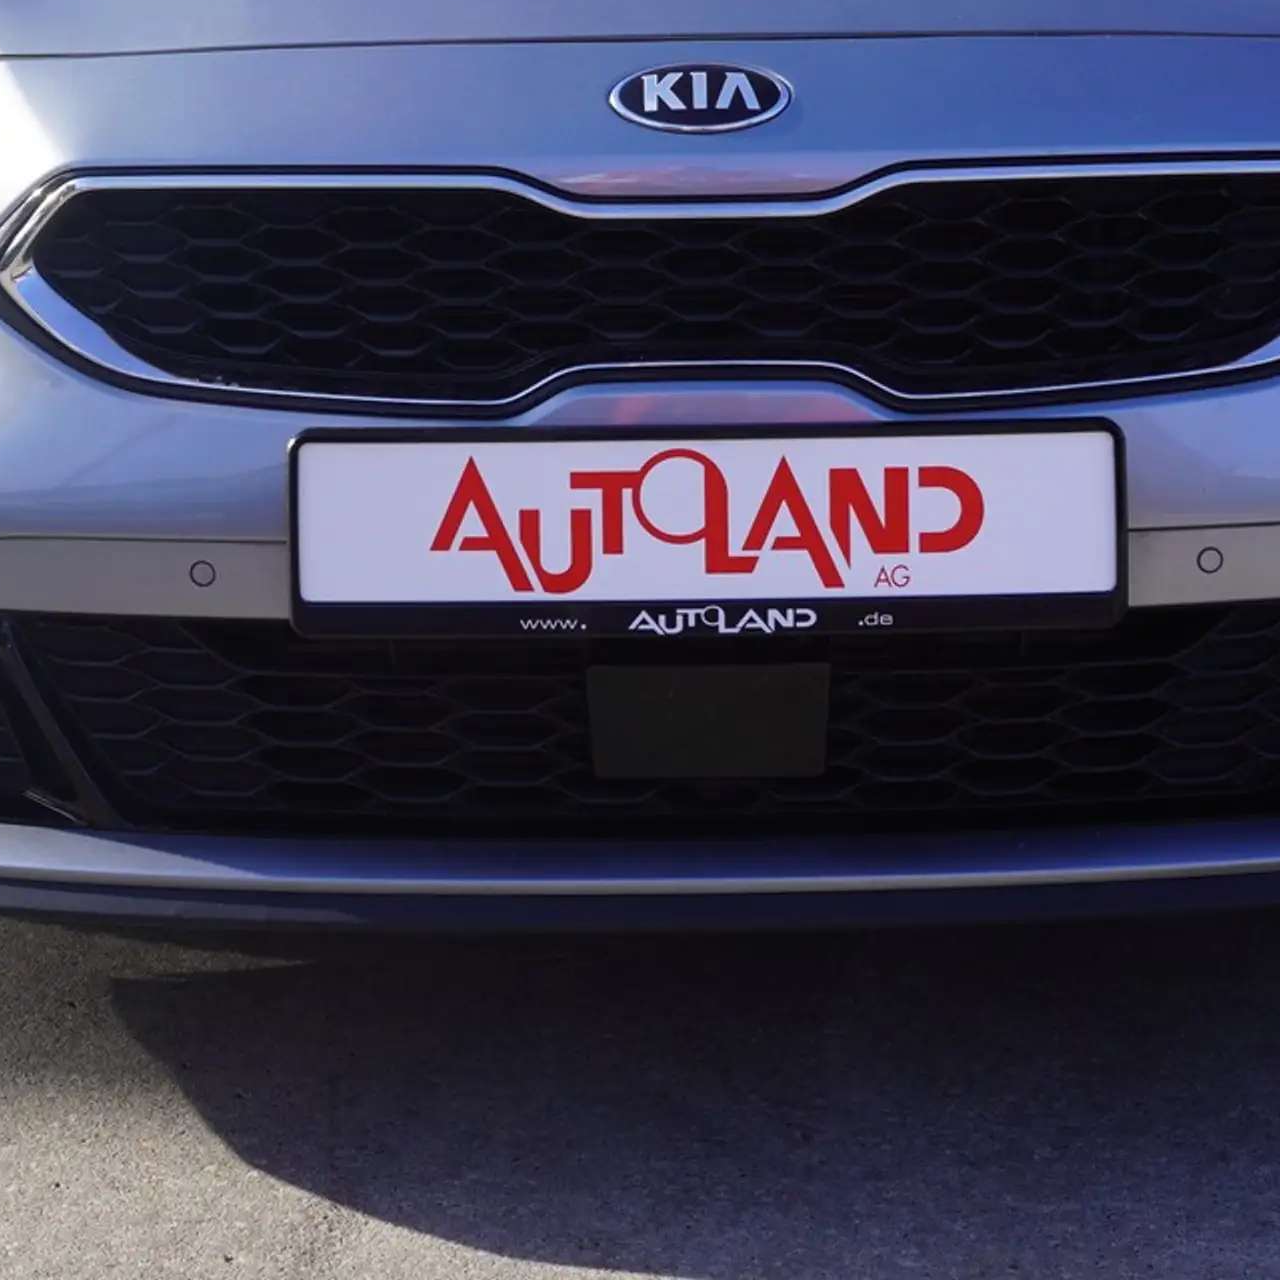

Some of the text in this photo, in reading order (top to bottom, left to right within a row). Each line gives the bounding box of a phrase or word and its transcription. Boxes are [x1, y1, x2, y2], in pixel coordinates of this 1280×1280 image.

[641, 70, 762, 113] KIA
[428, 447, 985, 594] AUTOLAND
[873, 564, 911, 588] AG
[520, 604, 894, 636] www. AUTOLAND .de
